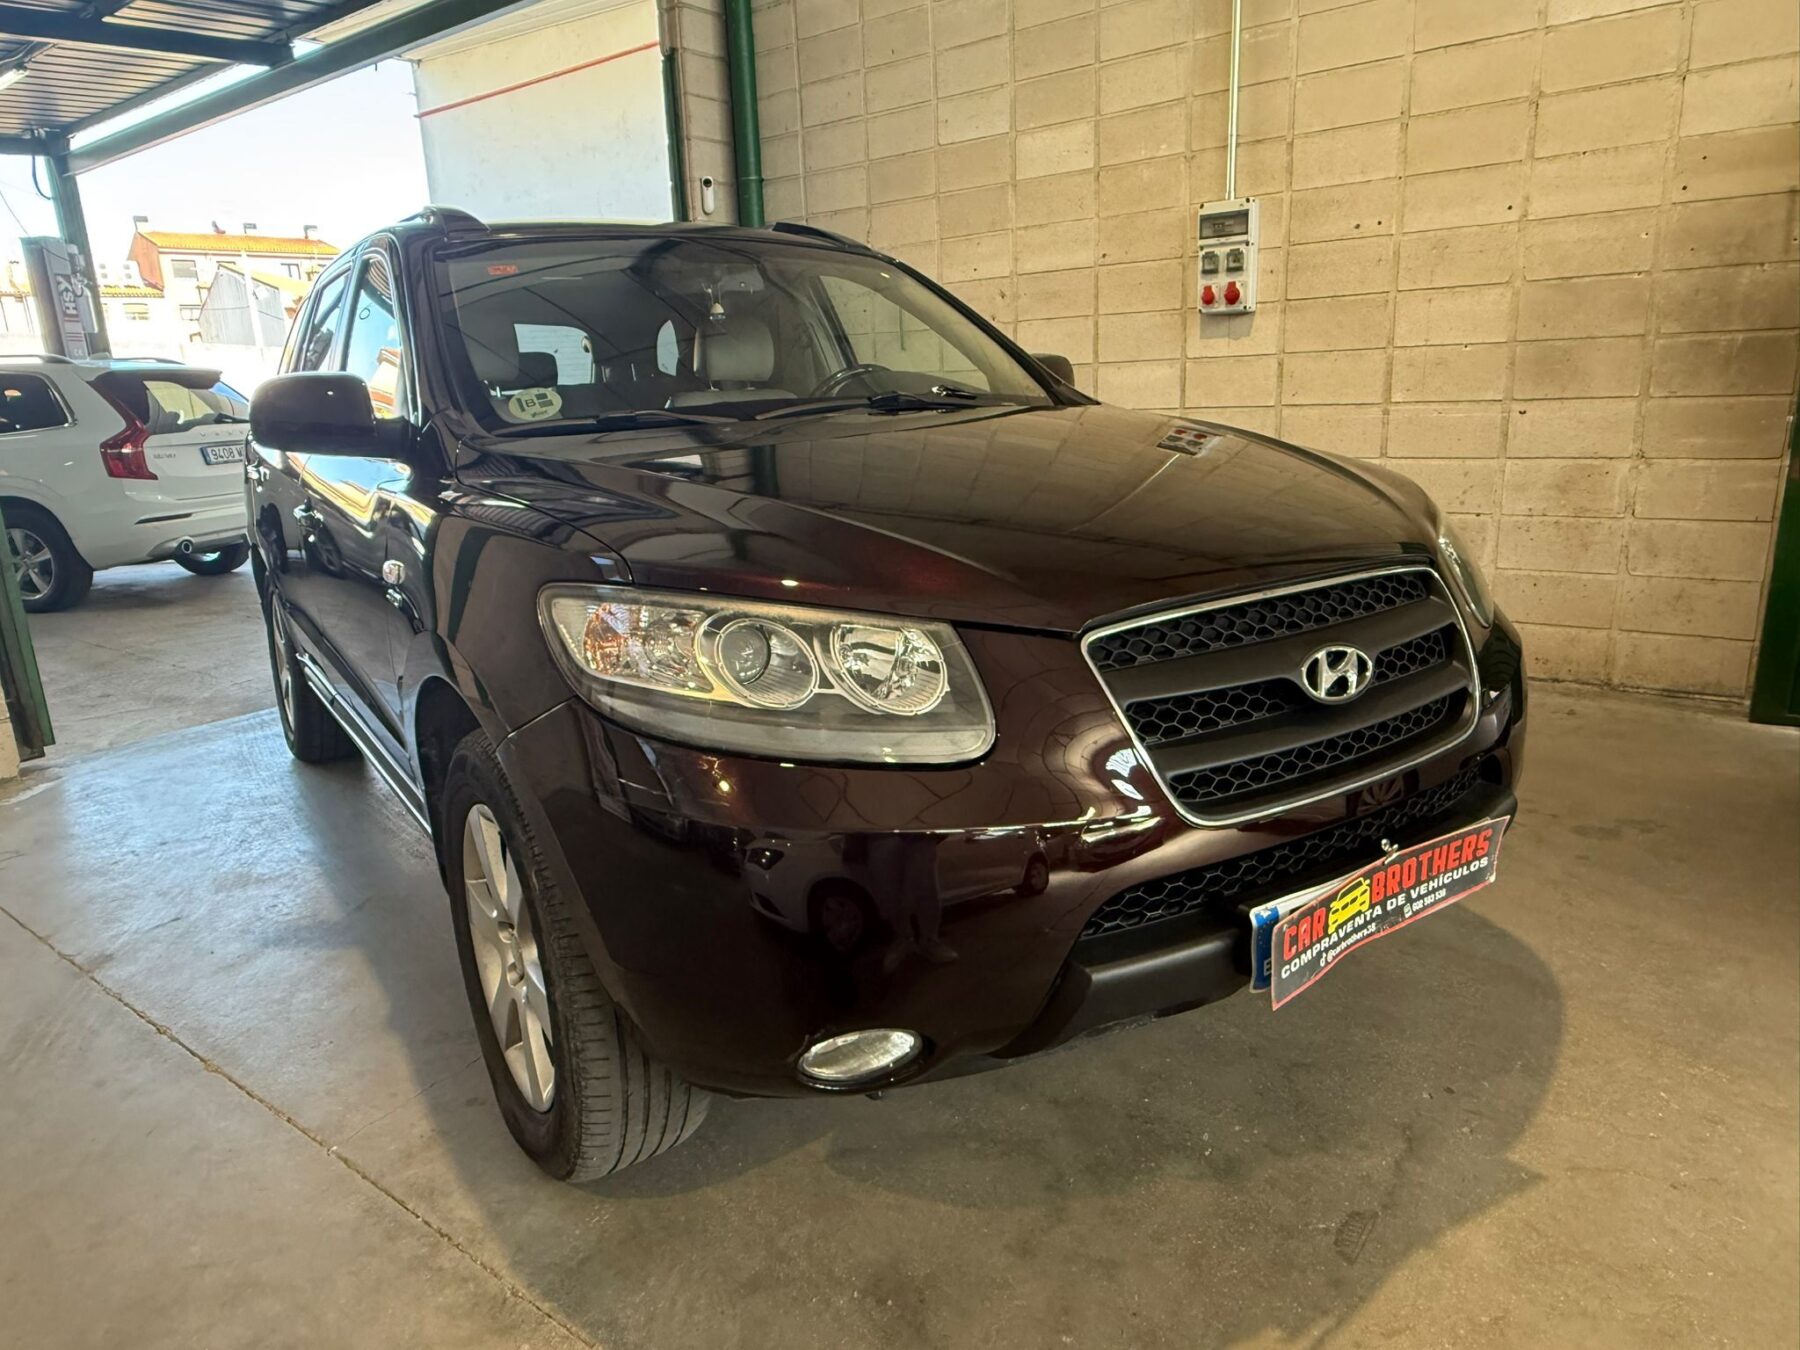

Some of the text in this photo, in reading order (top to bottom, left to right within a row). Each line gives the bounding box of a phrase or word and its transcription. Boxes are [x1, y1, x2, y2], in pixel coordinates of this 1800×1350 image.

[1281, 857, 1489, 979] COMPRAVENTA DE VEHÍCULOS
[1284, 828, 1493, 961] CAR BROTHERS
